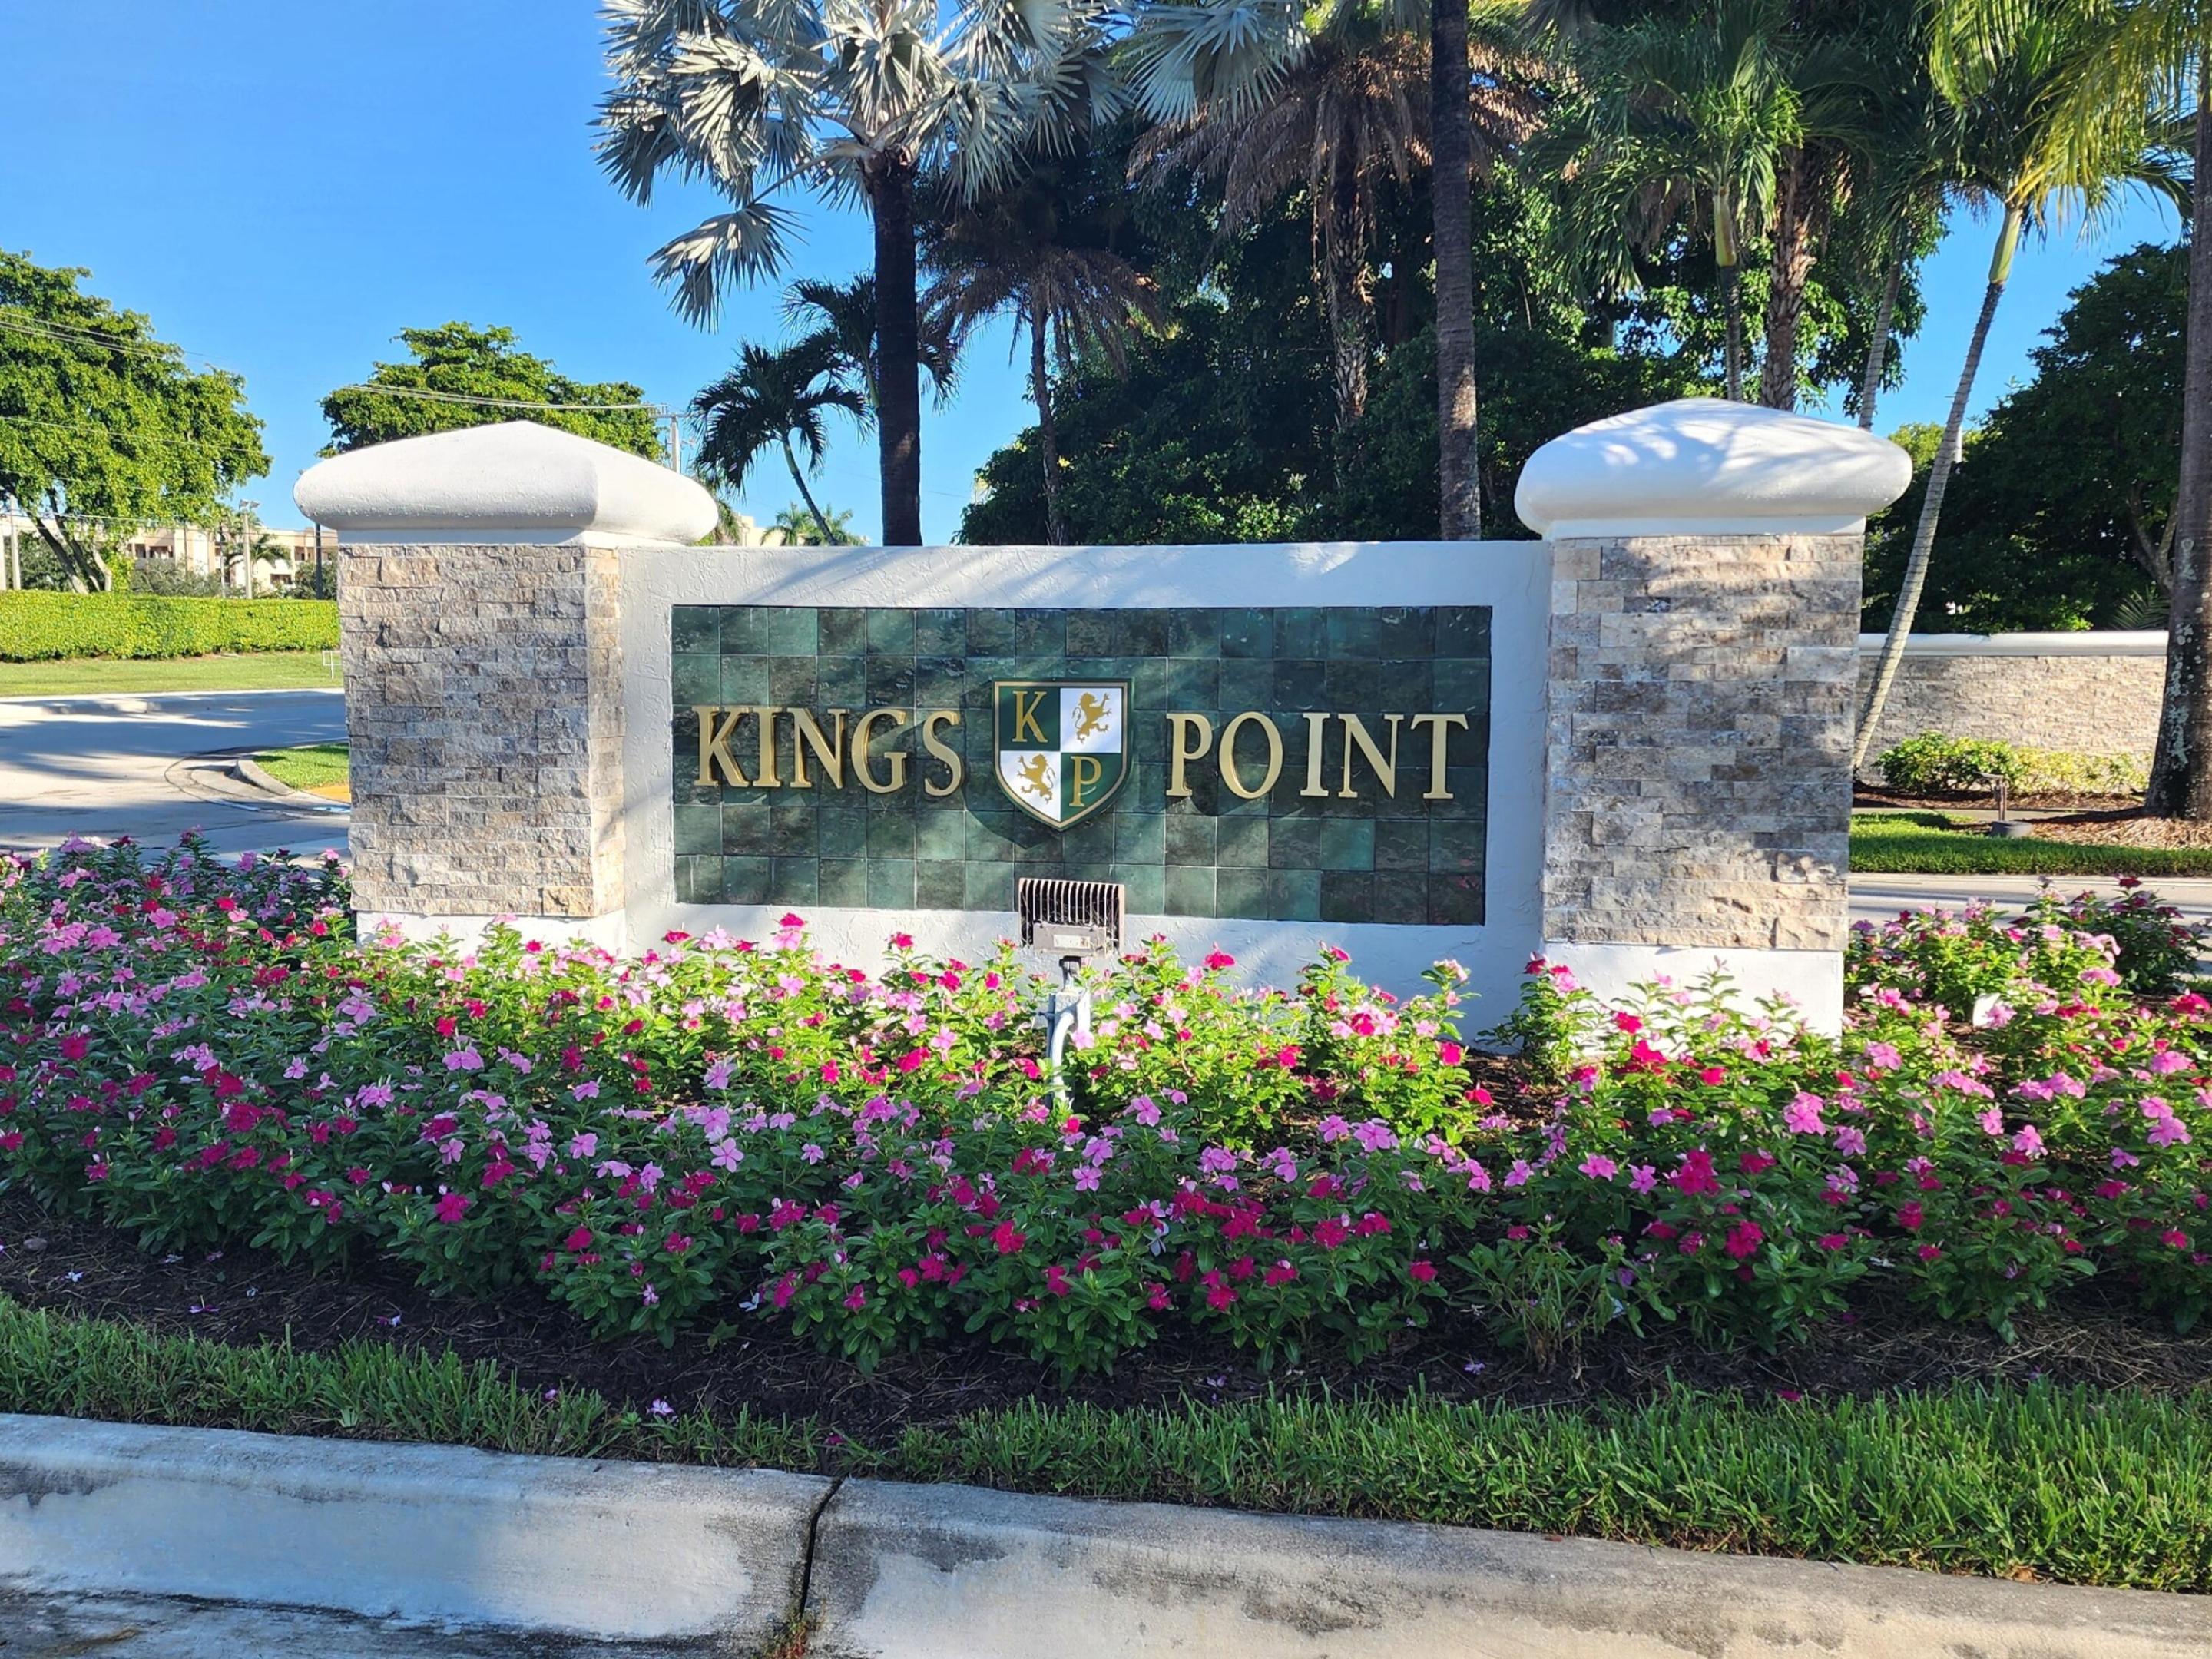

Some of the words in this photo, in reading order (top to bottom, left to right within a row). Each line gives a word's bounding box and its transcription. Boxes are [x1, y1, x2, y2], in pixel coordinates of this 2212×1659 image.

[1012, 690, 1048, 743] K
[692, 706, 964, 796] KINGS
[1165, 711, 1469, 800] POINT
[1068, 756, 1102, 806] P
